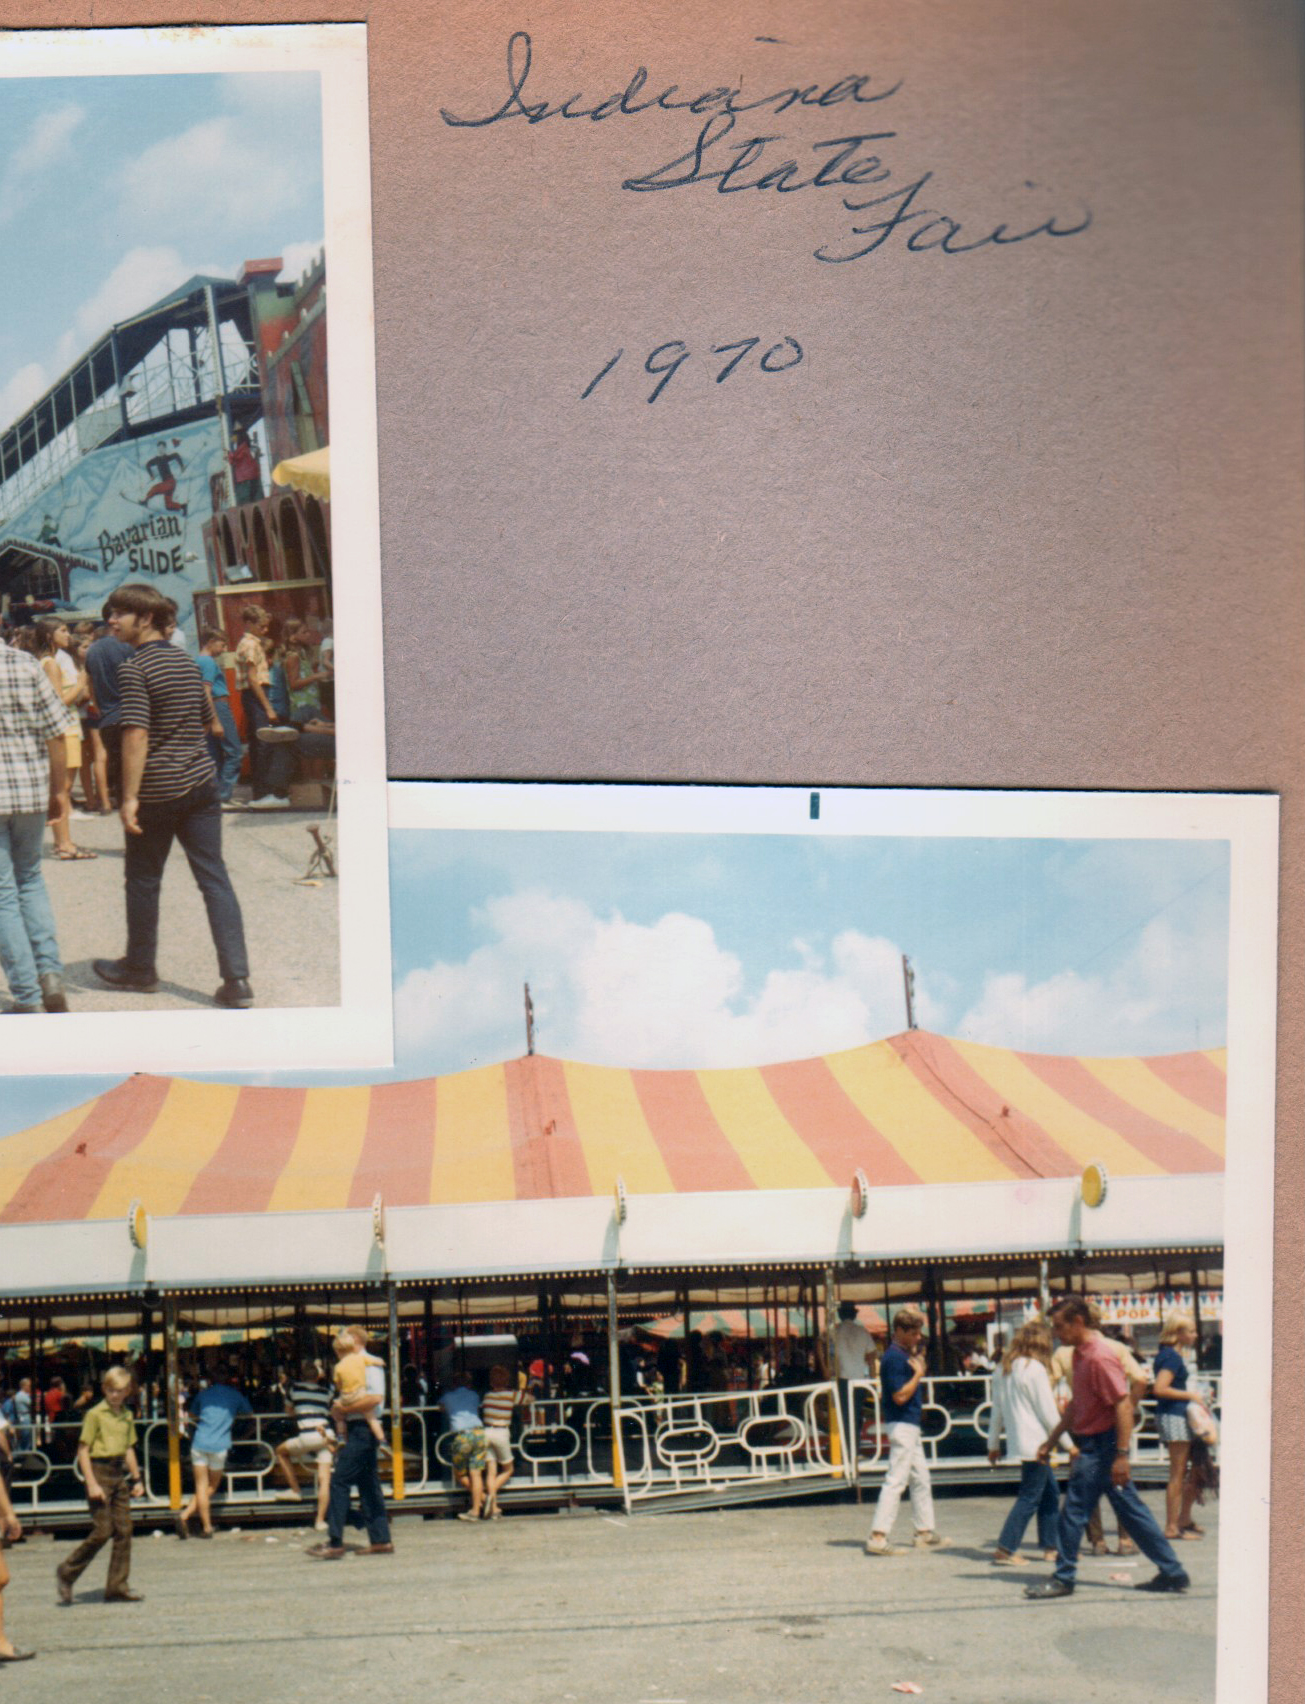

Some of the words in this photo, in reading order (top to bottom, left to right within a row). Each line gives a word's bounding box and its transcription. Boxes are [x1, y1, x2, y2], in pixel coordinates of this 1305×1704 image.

[440, 31, 903, 127] Indiana
[622, 112, 897, 193] State
[813, 171, 1091, 263] Fair
[581, 336, 803, 403] 1970
[97, 513, 182, 573] Bavarian
[128, 544, 185, 575] SLIDE
[1116, 1308, 1150, 1320] POP
